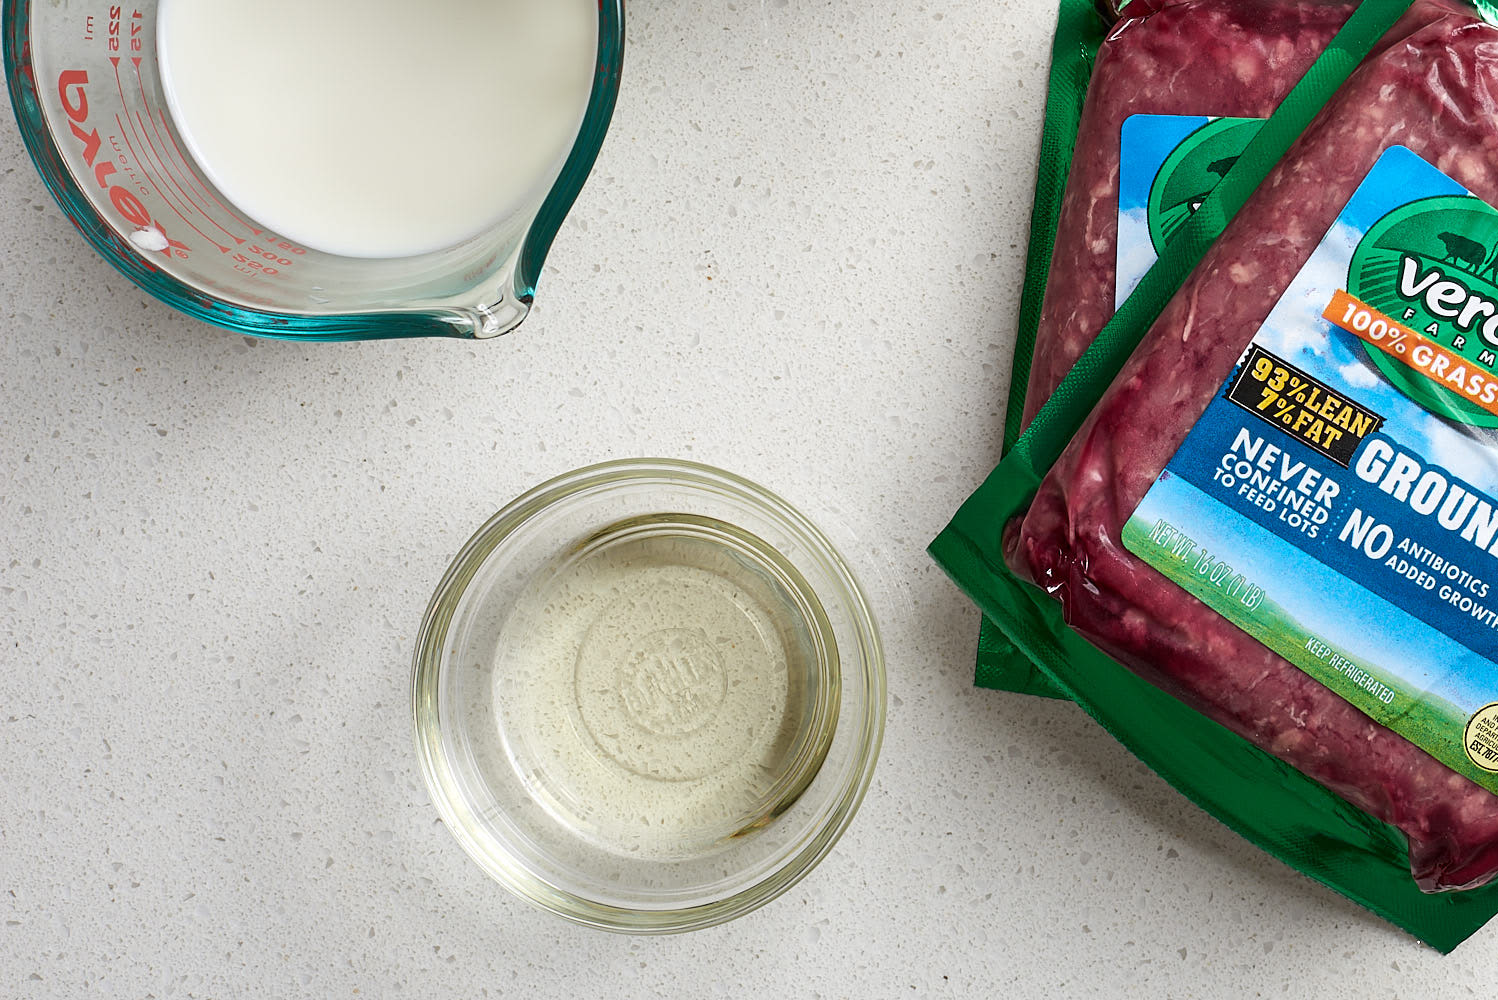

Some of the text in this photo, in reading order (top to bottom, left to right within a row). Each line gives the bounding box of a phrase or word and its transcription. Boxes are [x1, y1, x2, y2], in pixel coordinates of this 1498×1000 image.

[1341, 302, 1408, 354] 100%
[1213, 468, 1320, 539] TO FEED LOTS
[1222, 453, 1329, 525] CONFINED
[1230, 427, 1340, 510] NEVER
[1149, 519, 1266, 612] NET WT. 16 OZ (1 LB)
[1338, 508, 1490, 598] NO ANTIBIOTICS
[1385, 556, 1436, 592] ADDED
[1304, 637, 1395, 704] KEEP REFRIGERATED
[1482, 717, 1496, 728] AND
